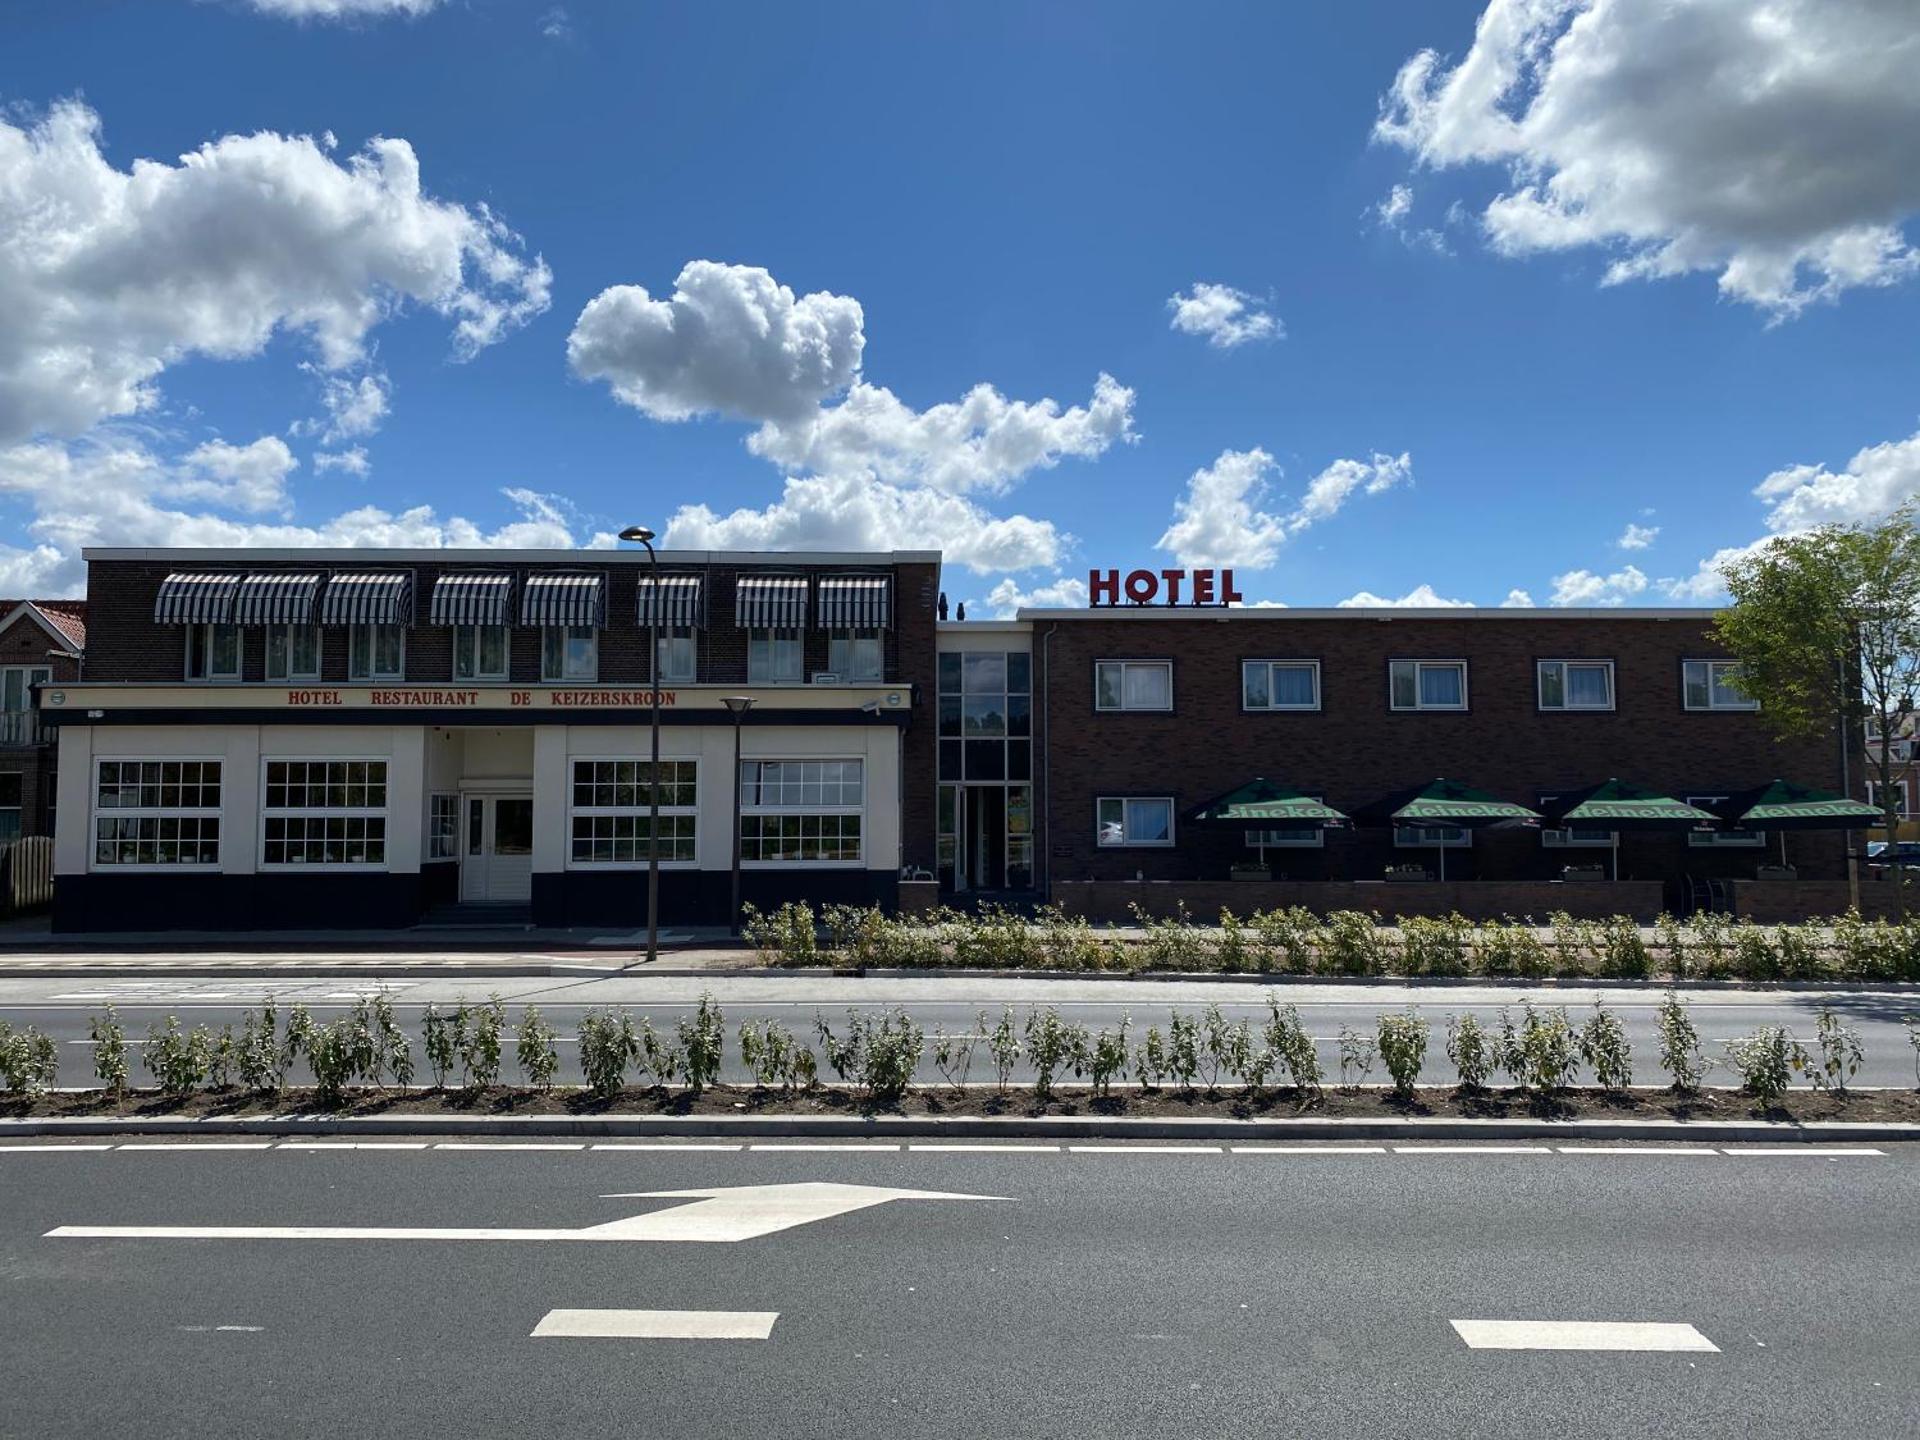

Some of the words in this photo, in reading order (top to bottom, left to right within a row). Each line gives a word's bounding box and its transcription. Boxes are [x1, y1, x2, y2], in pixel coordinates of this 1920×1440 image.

[1090, 569, 1242, 602] HOTEL
[288, 691, 342, 705] HOTEL
[371, 691, 479, 705] RESTAURANT
[511, 692, 531, 705] DE
[552, 692, 676, 705] KEIZERSKROON
[1227, 805, 1338, 818] eineken
